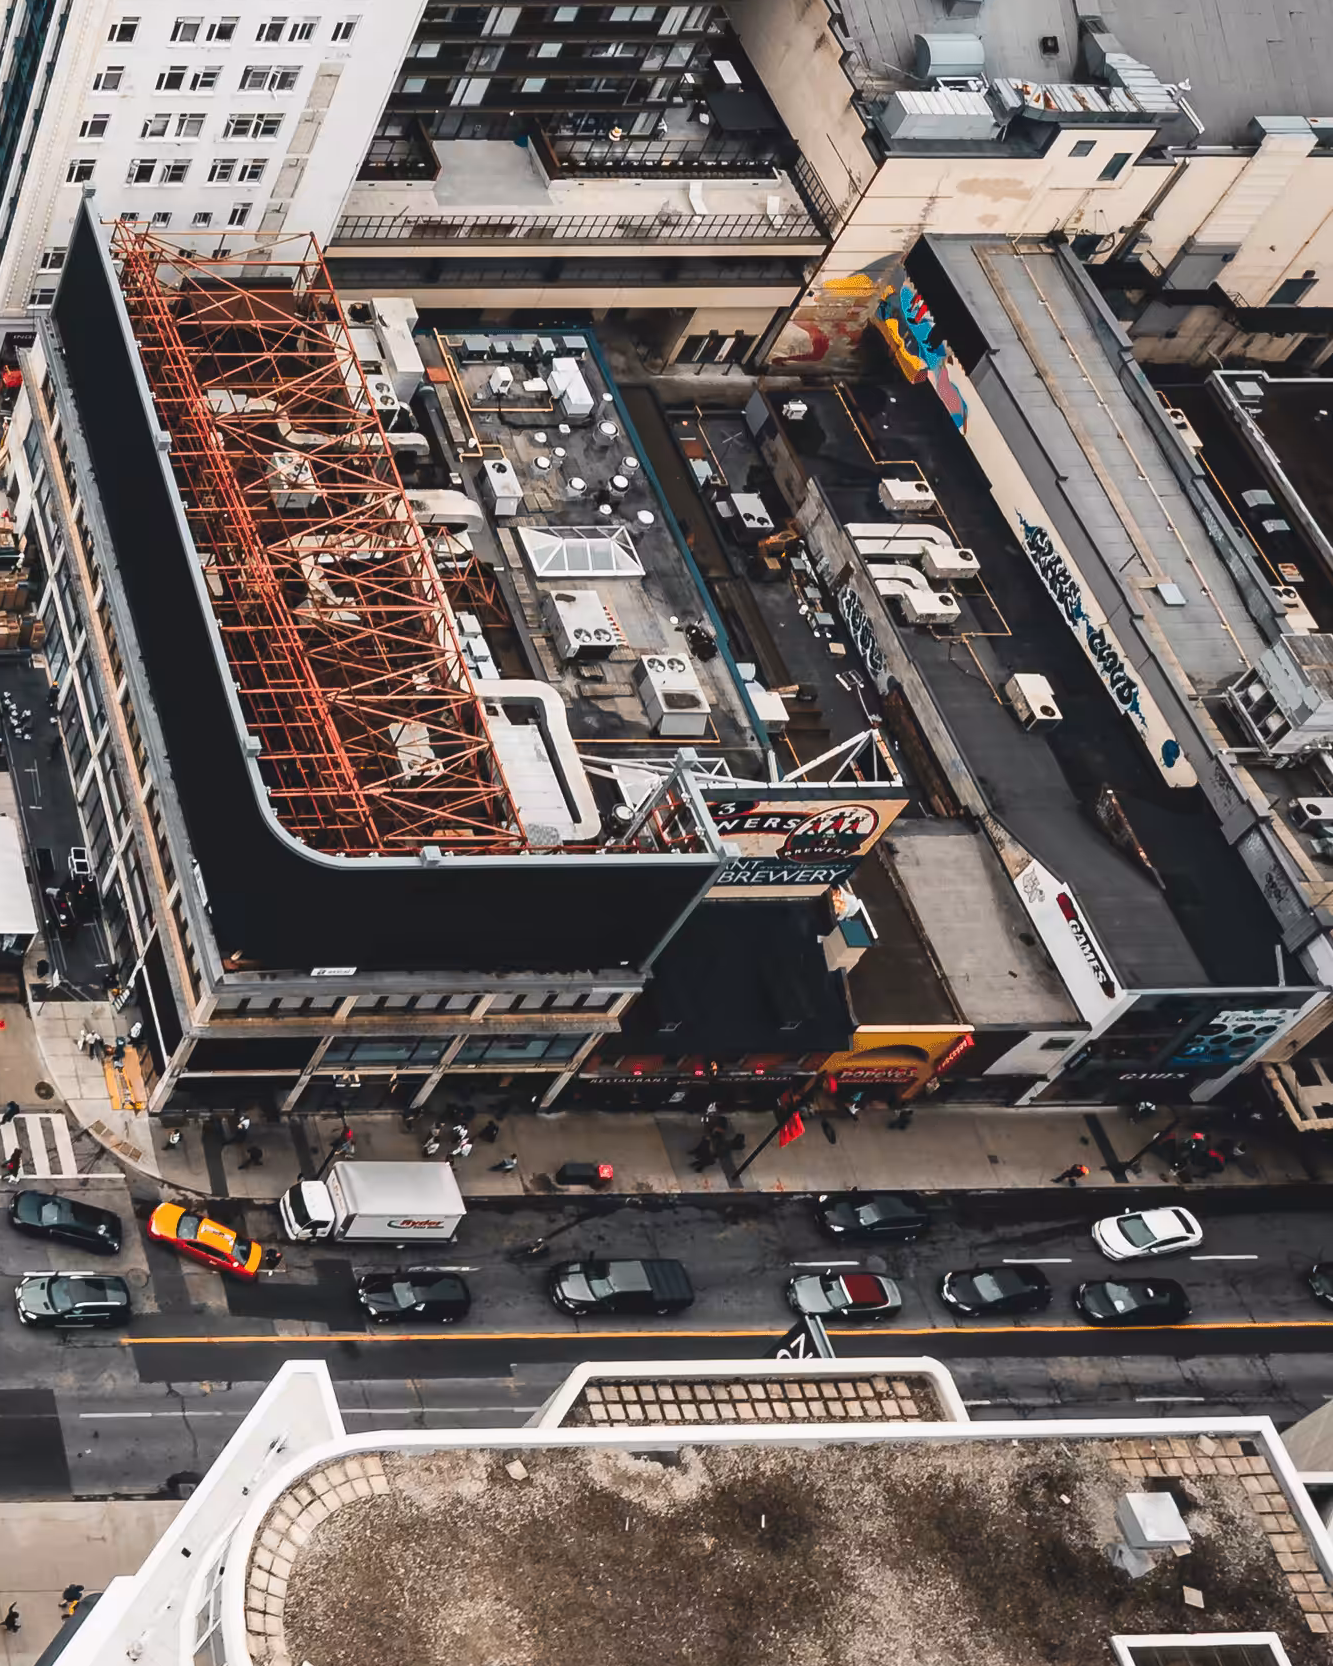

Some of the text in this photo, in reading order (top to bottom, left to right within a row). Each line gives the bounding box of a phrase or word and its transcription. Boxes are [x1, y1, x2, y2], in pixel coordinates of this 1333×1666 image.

[718, 802, 736, 815] 3
[785, 847, 849, 856] BREWERS
[717, 869, 846, 884] BREWERY
[1067, 919, 1108, 986] GAMES
